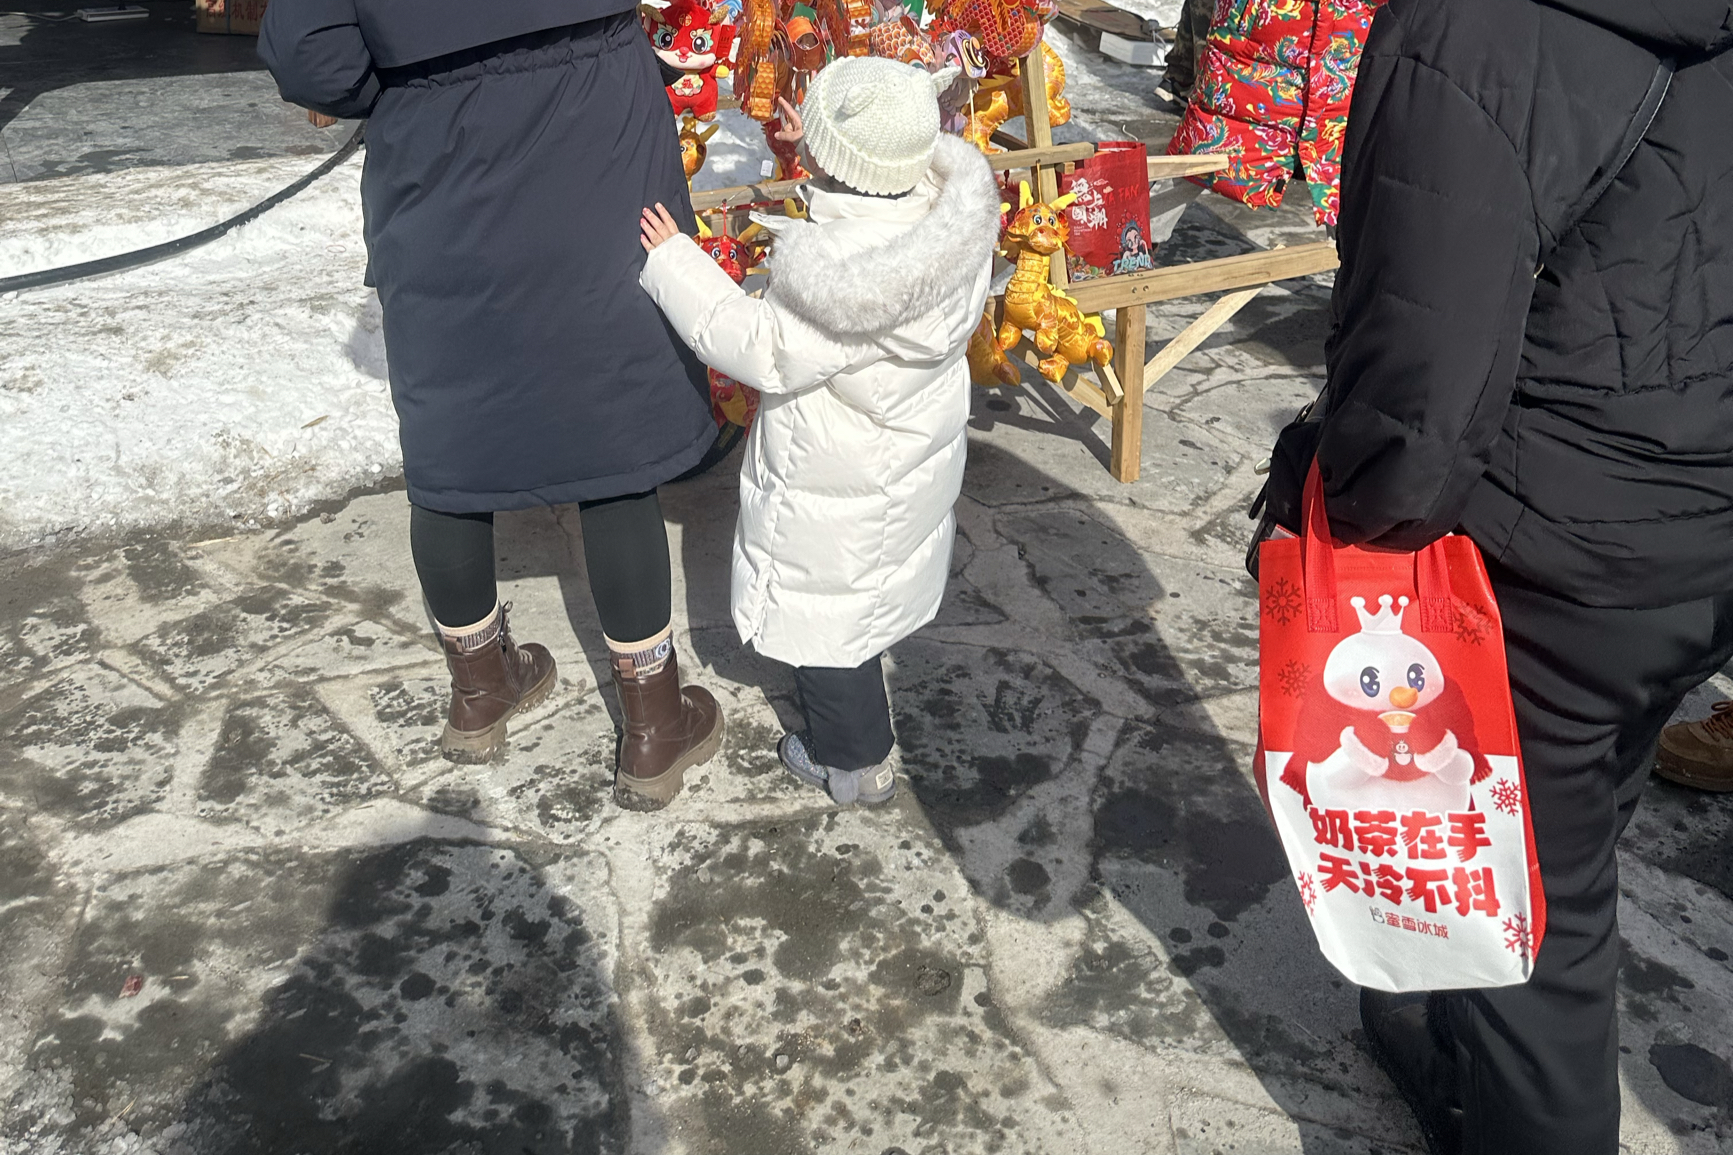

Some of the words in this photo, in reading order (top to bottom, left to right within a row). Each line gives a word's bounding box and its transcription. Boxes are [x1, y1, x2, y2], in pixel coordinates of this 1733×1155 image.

[1118, 183, 1140, 203] FAN
[1309, 806, 1492, 863] 奶茶在手
[1317, 851, 1501, 917] 天冷不抖
[1385, 911, 1449, 940] 蜜雪冰城
